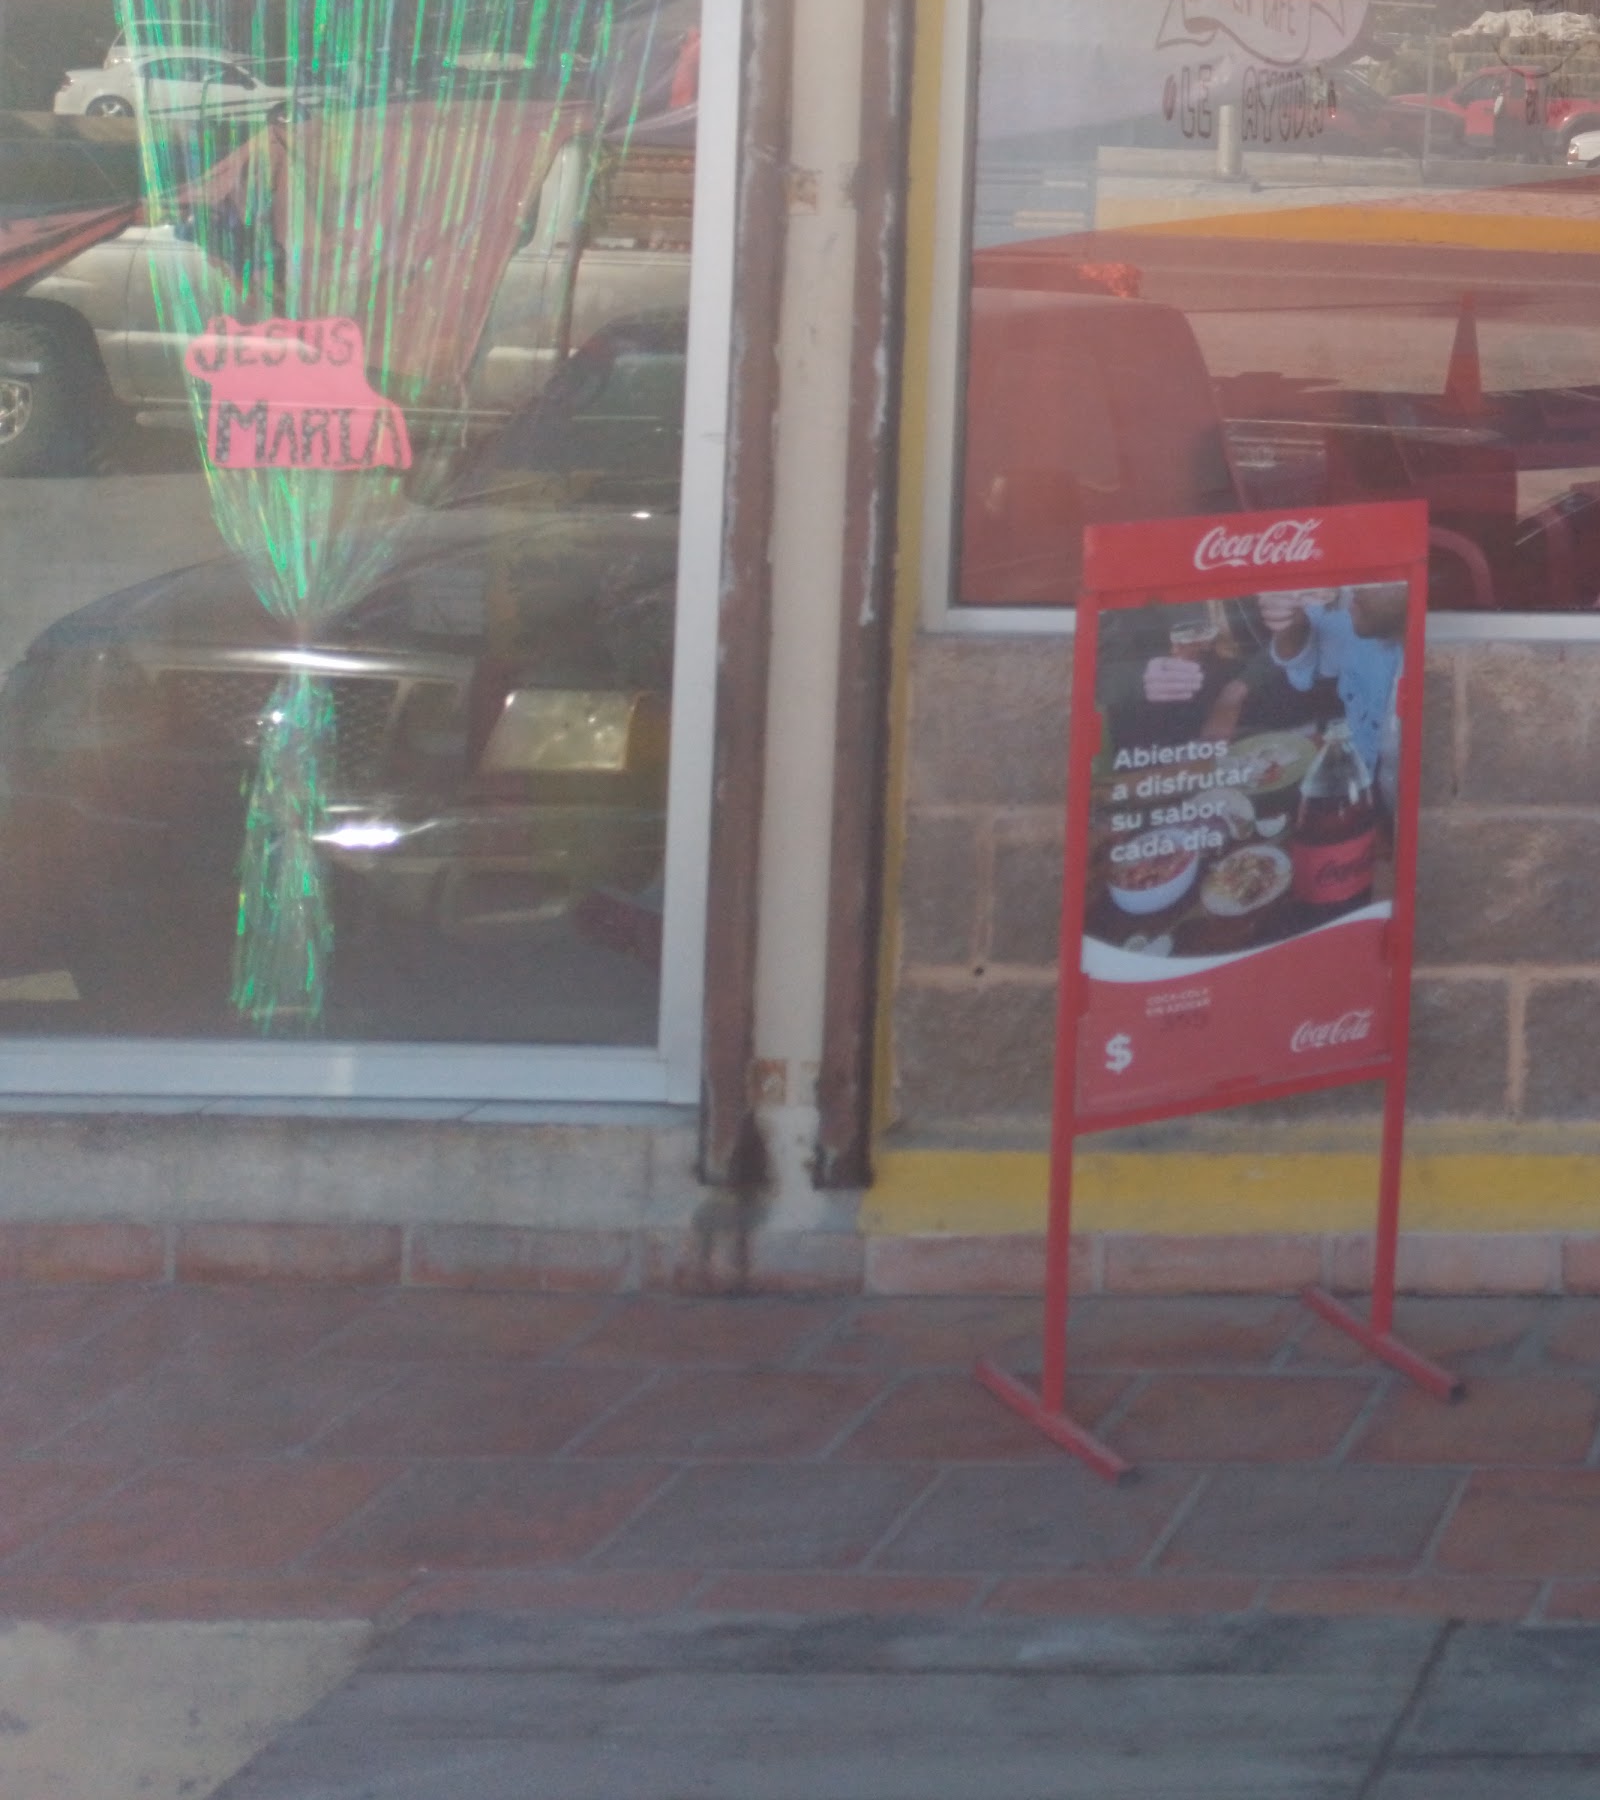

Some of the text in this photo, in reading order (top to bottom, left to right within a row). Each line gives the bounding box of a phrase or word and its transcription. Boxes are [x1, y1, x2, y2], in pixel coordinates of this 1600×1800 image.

[193, 317, 355, 373] JESUS
[214, 400, 410, 467] MARIA
[1193, 518, 1323, 570] Coca-Cola
[1113, 738, 1229, 772] Abiertos
[1112, 764, 1252, 801] a disfrutar
[1111, 799, 1228, 833] su sabor
[1109, 833, 1176, 865] cada
[1104, 1032, 1133, 1074] $
